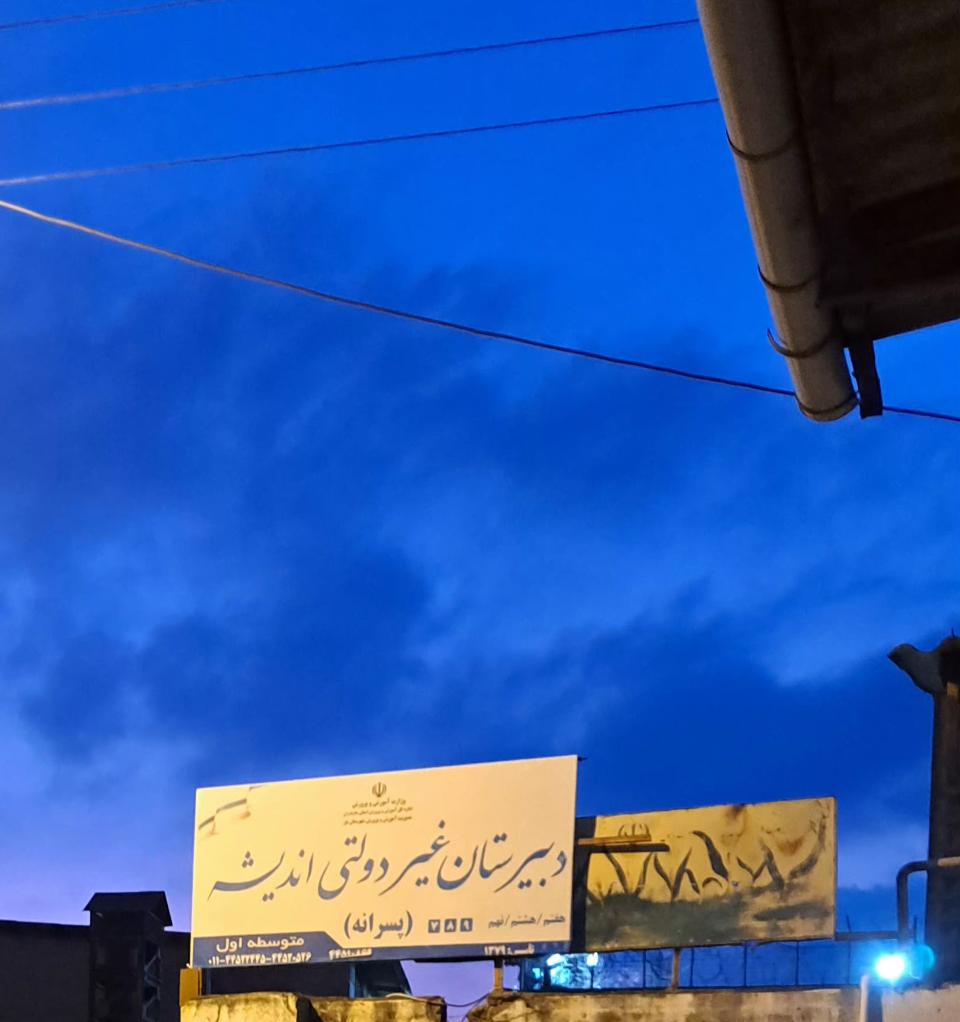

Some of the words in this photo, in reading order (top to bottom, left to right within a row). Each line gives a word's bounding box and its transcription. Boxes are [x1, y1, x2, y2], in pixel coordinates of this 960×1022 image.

[436, 831, 568, 894] دبیرستان
[343, 909, 413, 940] (پسرانه)
[216, 936, 243, 953] اول
[246, 936, 305, 950] متوسطه
